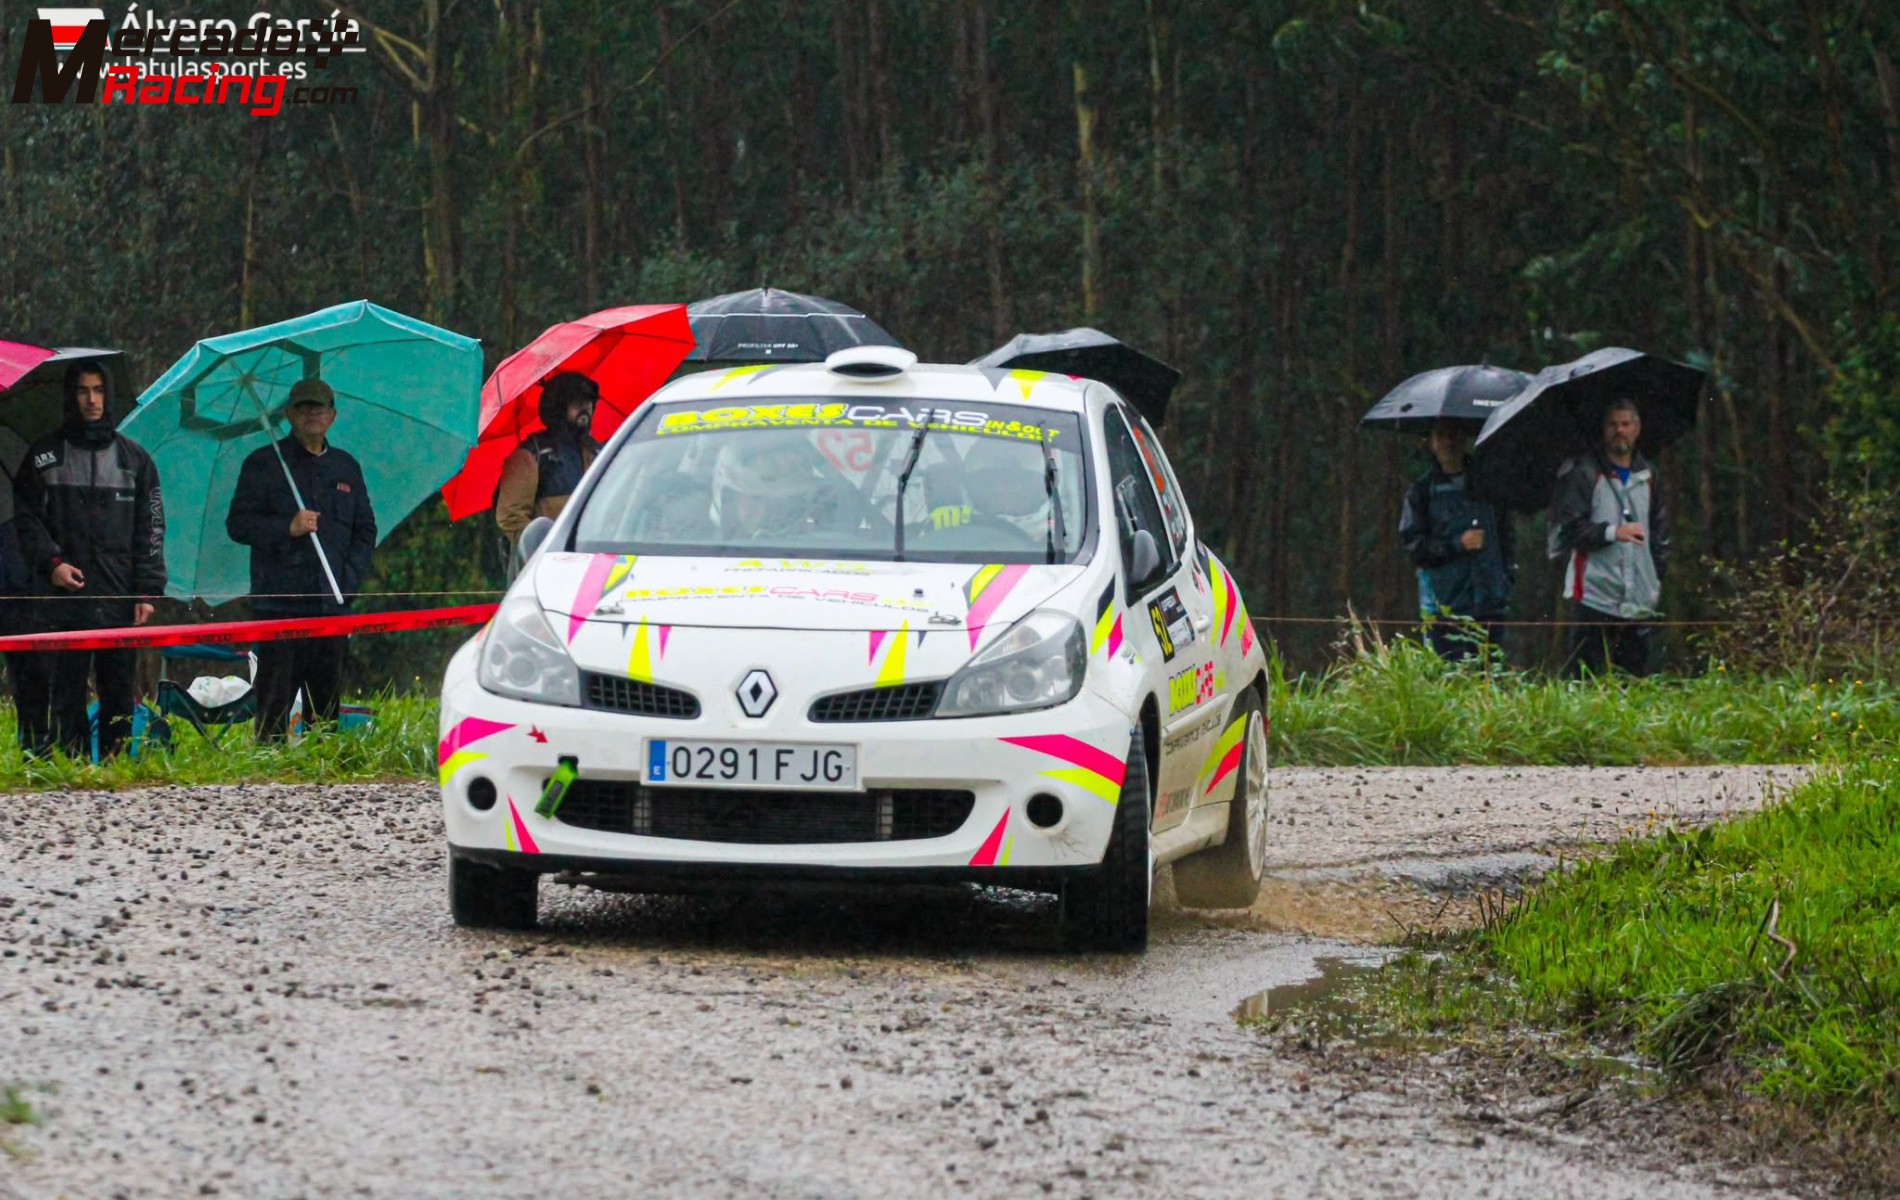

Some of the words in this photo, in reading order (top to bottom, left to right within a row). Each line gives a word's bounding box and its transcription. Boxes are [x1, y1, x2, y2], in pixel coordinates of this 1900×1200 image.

[863, 419, 898, 428] DE
[672, 745, 758, 781] 0291
[775, 749, 843, 782] FJG
[653, 766, 661, 775] E
